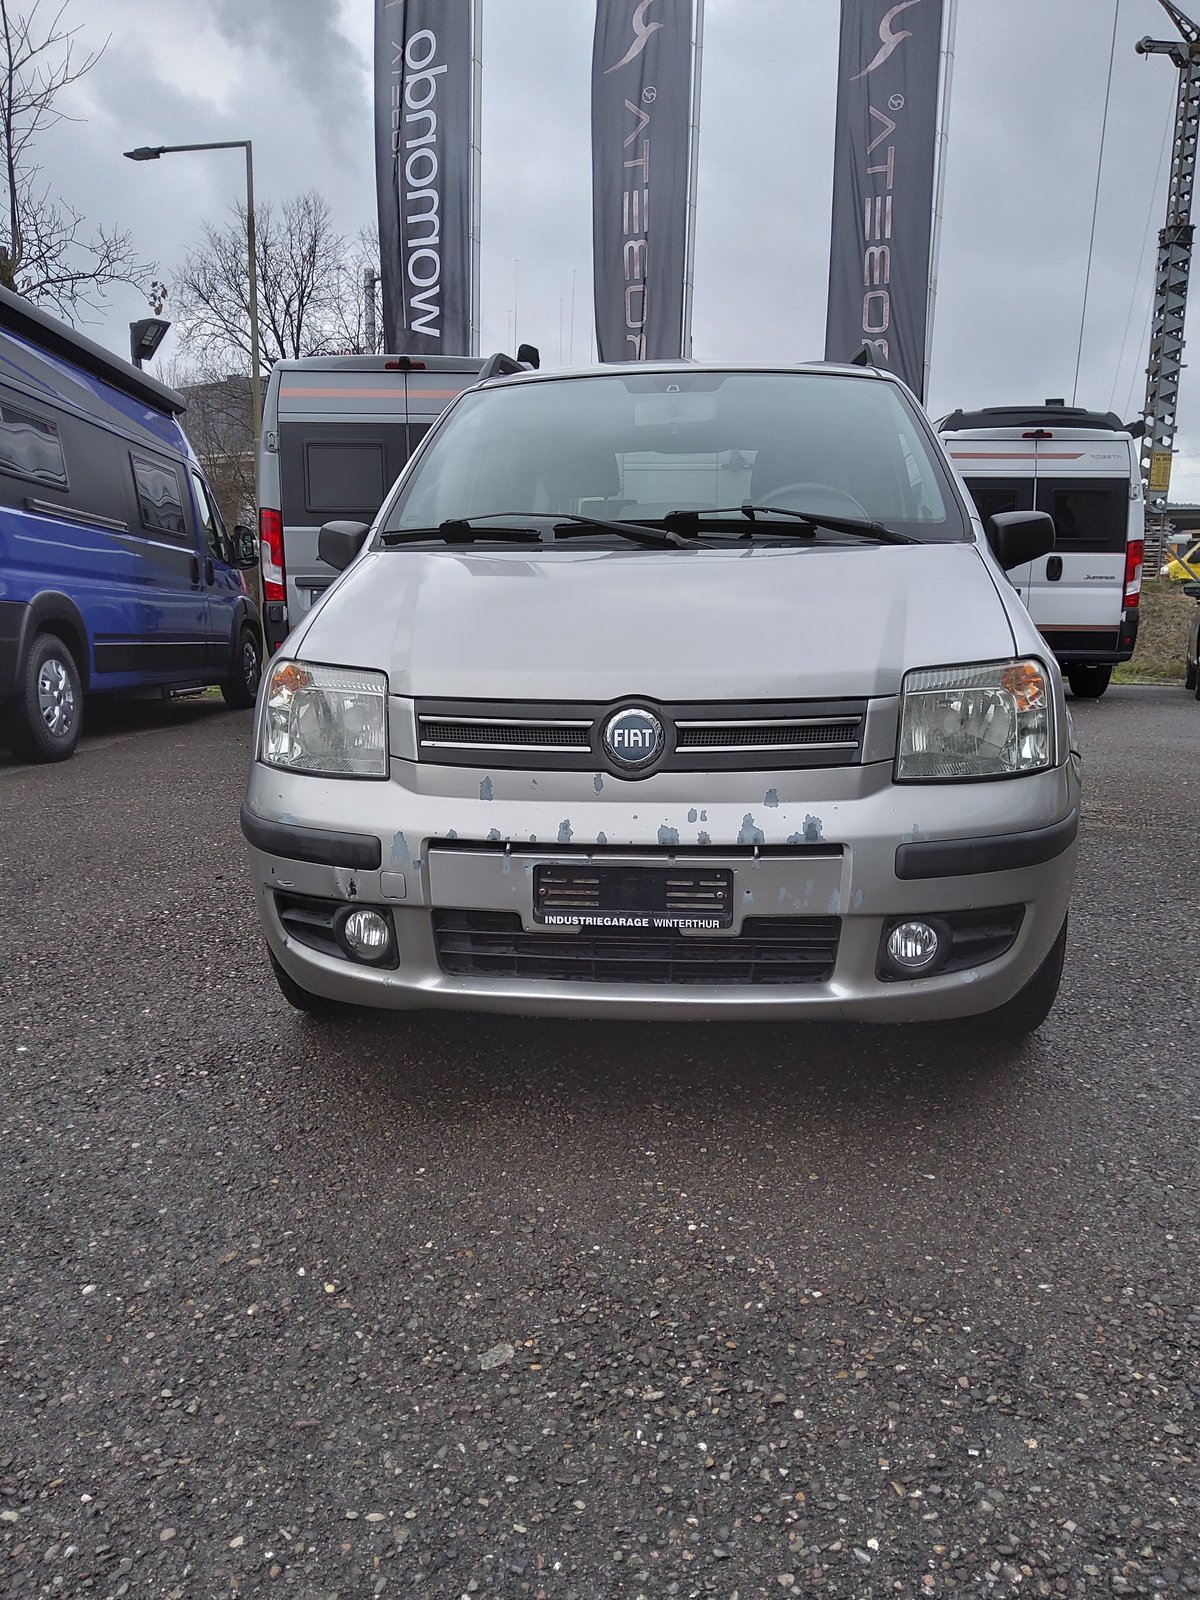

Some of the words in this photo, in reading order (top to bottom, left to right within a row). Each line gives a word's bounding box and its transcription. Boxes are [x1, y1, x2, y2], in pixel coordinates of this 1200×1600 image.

[613, 729, 653, 748] FIAT
[544, 915, 649, 927] INDUSTRIEGARAGE
[653, 918, 720, 929] WINTERTHUR
